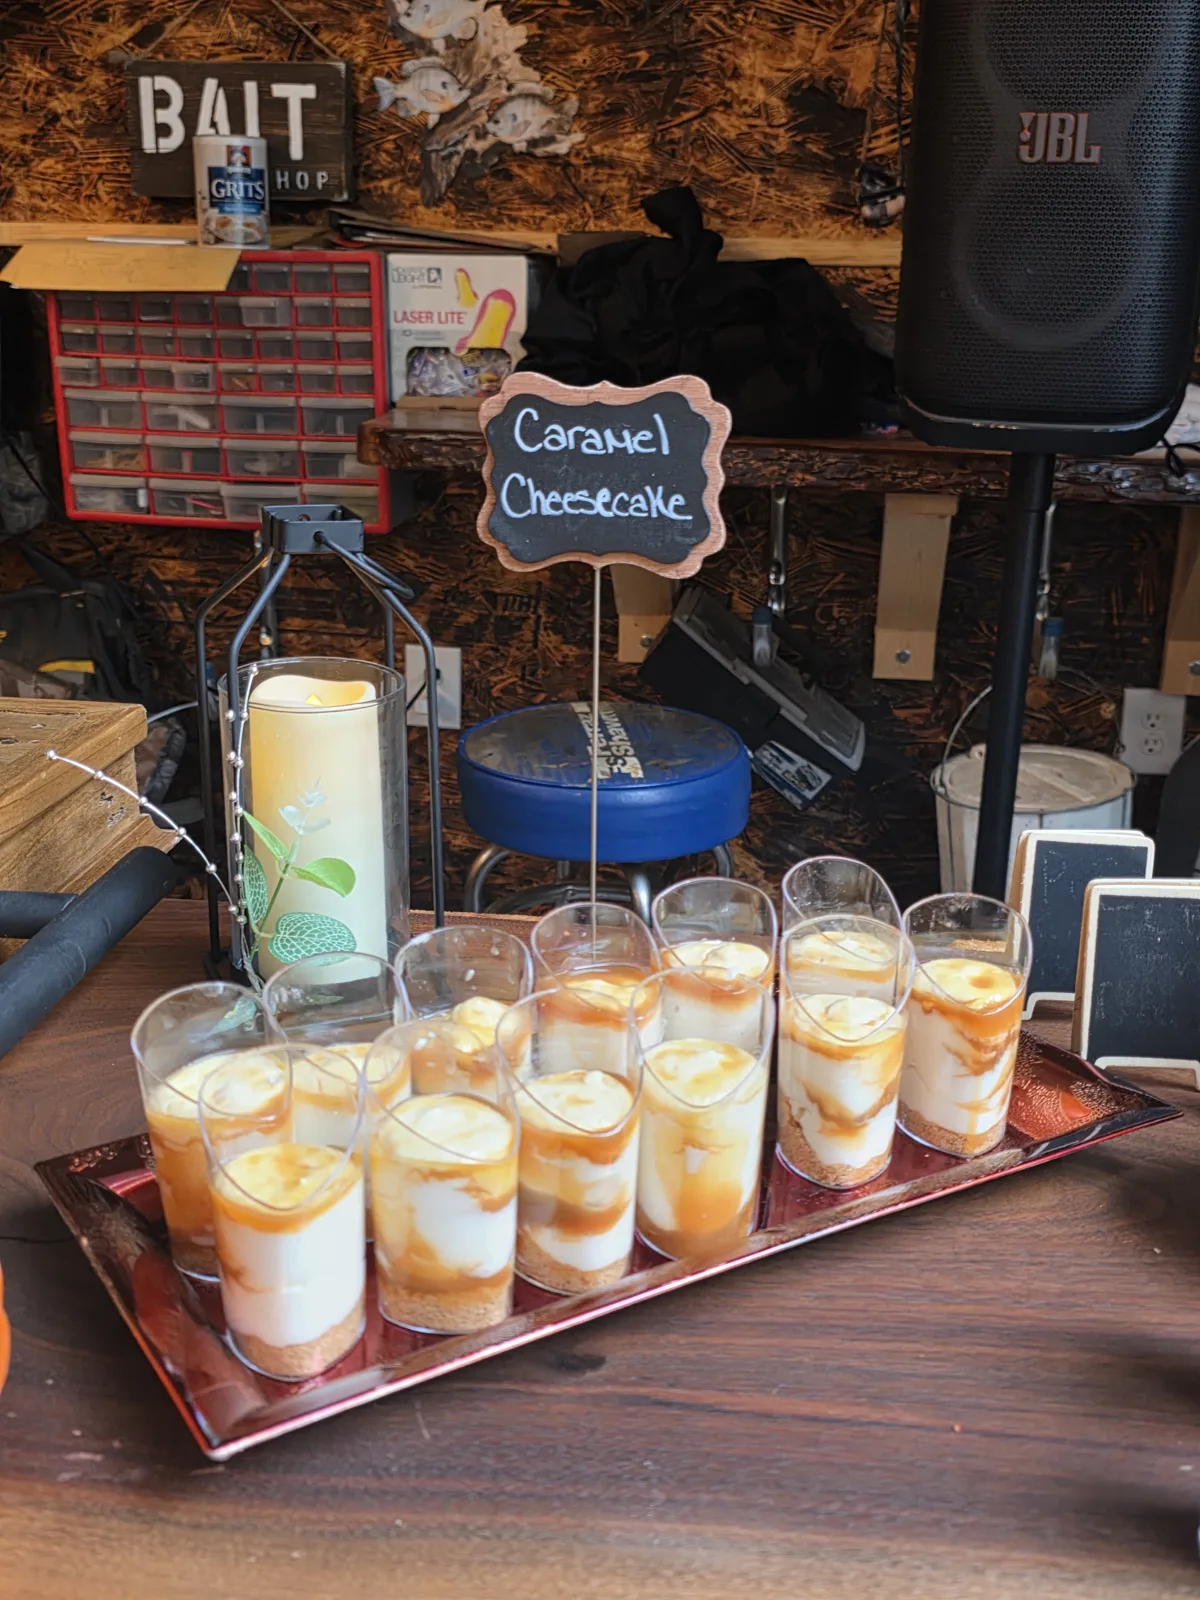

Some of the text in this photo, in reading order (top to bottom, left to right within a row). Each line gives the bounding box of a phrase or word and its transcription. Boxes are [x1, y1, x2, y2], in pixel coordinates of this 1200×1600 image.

[138, 75, 317, 160] BAIT
[1019, 112, 1100, 163] JBL
[211, 179, 265, 200] GRITS
[276, 170, 329, 190] HOP
[393, 310, 465, 324] LASER LITE
